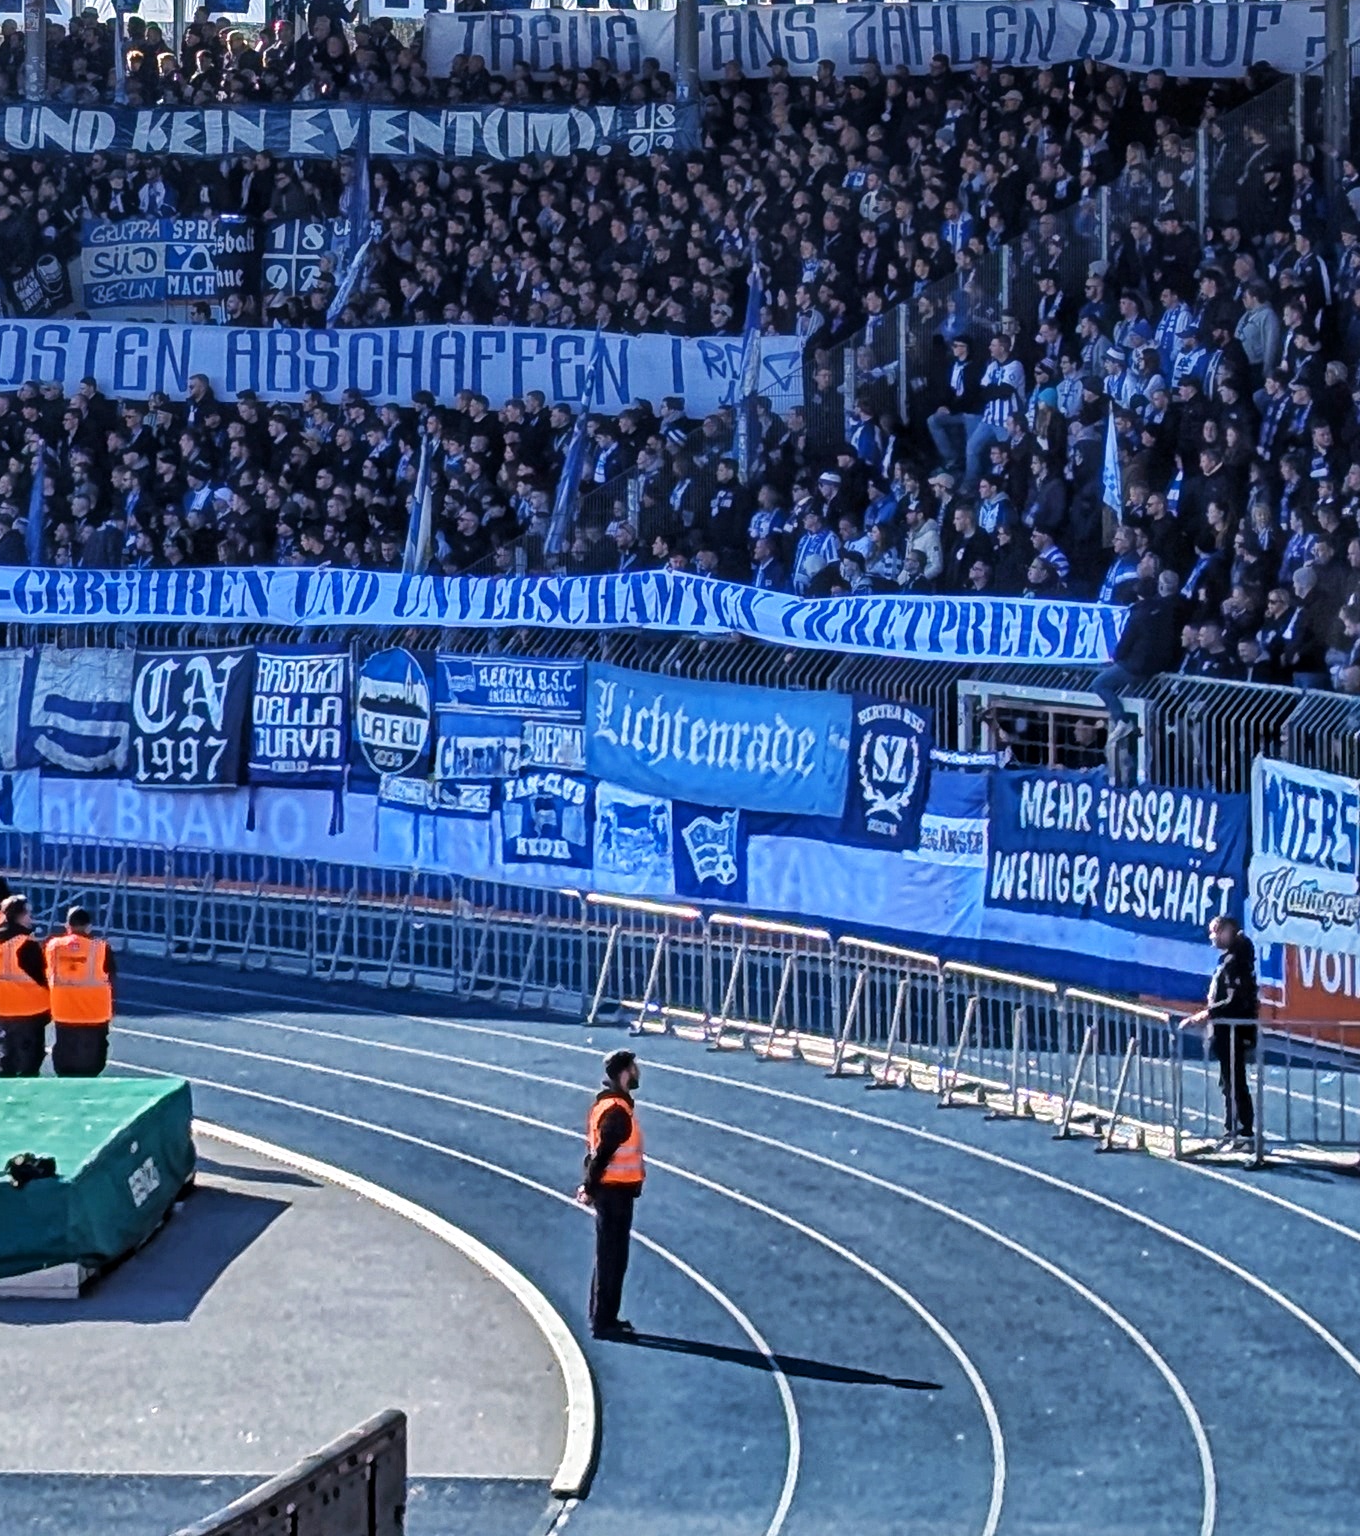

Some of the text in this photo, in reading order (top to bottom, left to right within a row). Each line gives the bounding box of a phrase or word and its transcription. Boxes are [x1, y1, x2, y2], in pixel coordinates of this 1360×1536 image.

[698, 7, 819, 65] ANS
[845, 4, 1057, 67] ZAHLEN
[1077, 4, 1282, 66] DRAUF
[5, 105, 116, 154] UND
[133, 107, 266, 155] KEIN
[90, 221, 161, 244] GRUPPA
[92, 280, 157, 303] BERLIN
[226, 326, 630, 406] ABSCHAFFEN
[293, 569, 381, 617] UND
[394, 572, 777, 632] UNVERSCHÄMTEN
[256, 656, 344, 694] RAGAZZI
[252, 695, 343, 726] DELLA
[593, 677, 818, 778] Lichtenrade
[132, 735, 229, 783] 1997
[254, 727, 340, 759] CURVA
[503, 772, 588, 805] FAN-CLUB
[1020, 779, 1218, 851] MEHR FUSSBALL
[990, 850, 1236, 926] WENIGER GESCHÄFT
